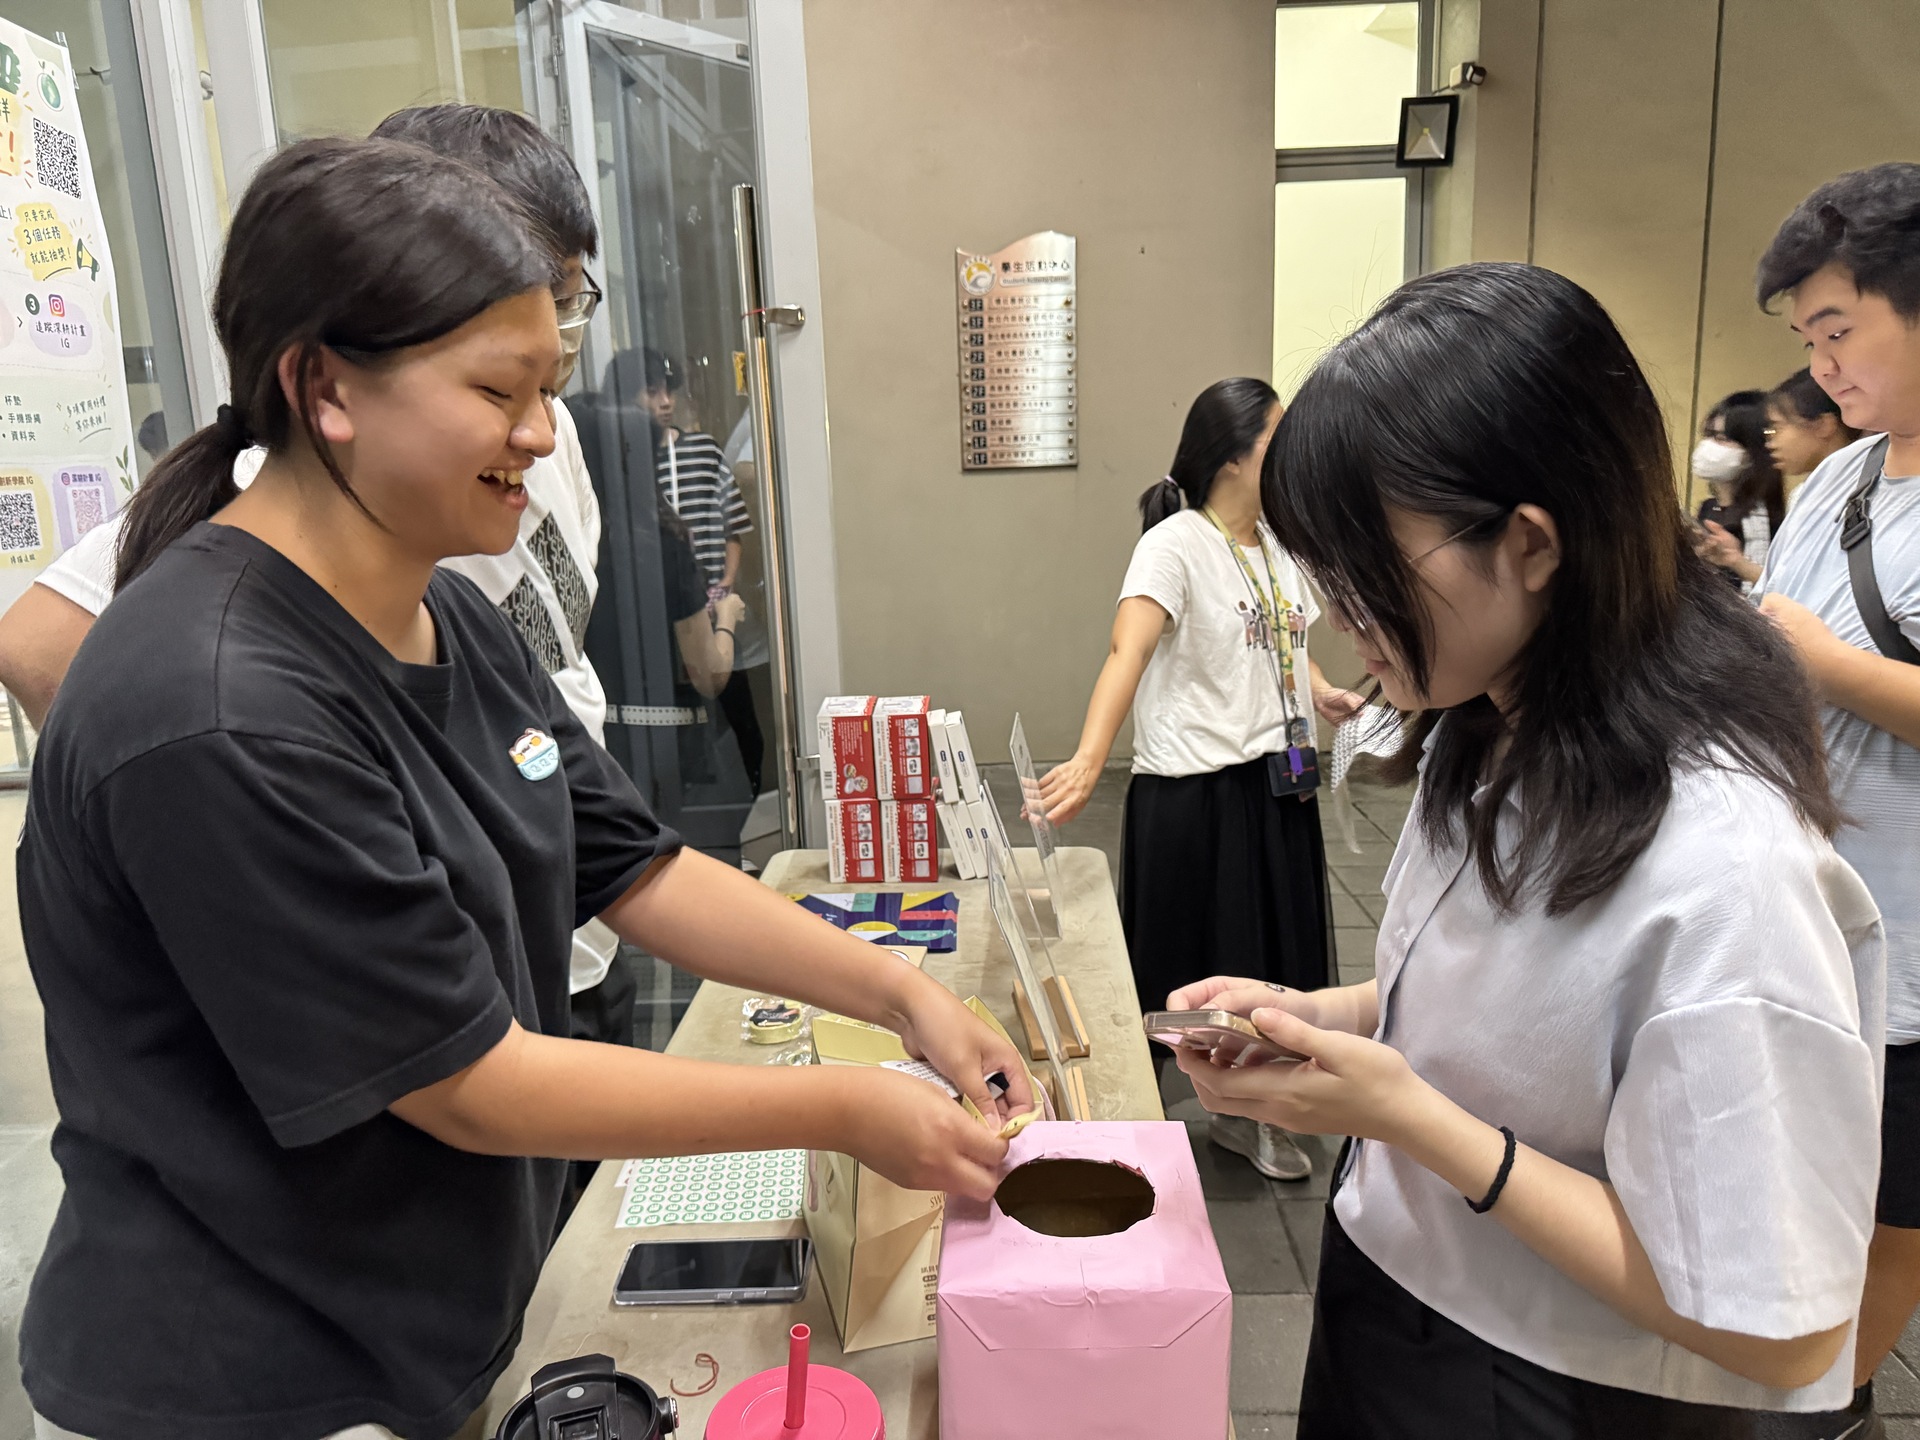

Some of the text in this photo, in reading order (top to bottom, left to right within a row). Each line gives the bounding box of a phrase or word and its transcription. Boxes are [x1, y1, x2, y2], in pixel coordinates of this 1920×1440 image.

[24, 209, 55, 222] 只要完成
[24, 226, 62, 245] 3個任務
[30, 246, 72, 265] 就能抽獎!
[60, 338, 70, 348] IG
[11, 430, 37, 441] 資料夾
[26, 475, 34, 485] IG
